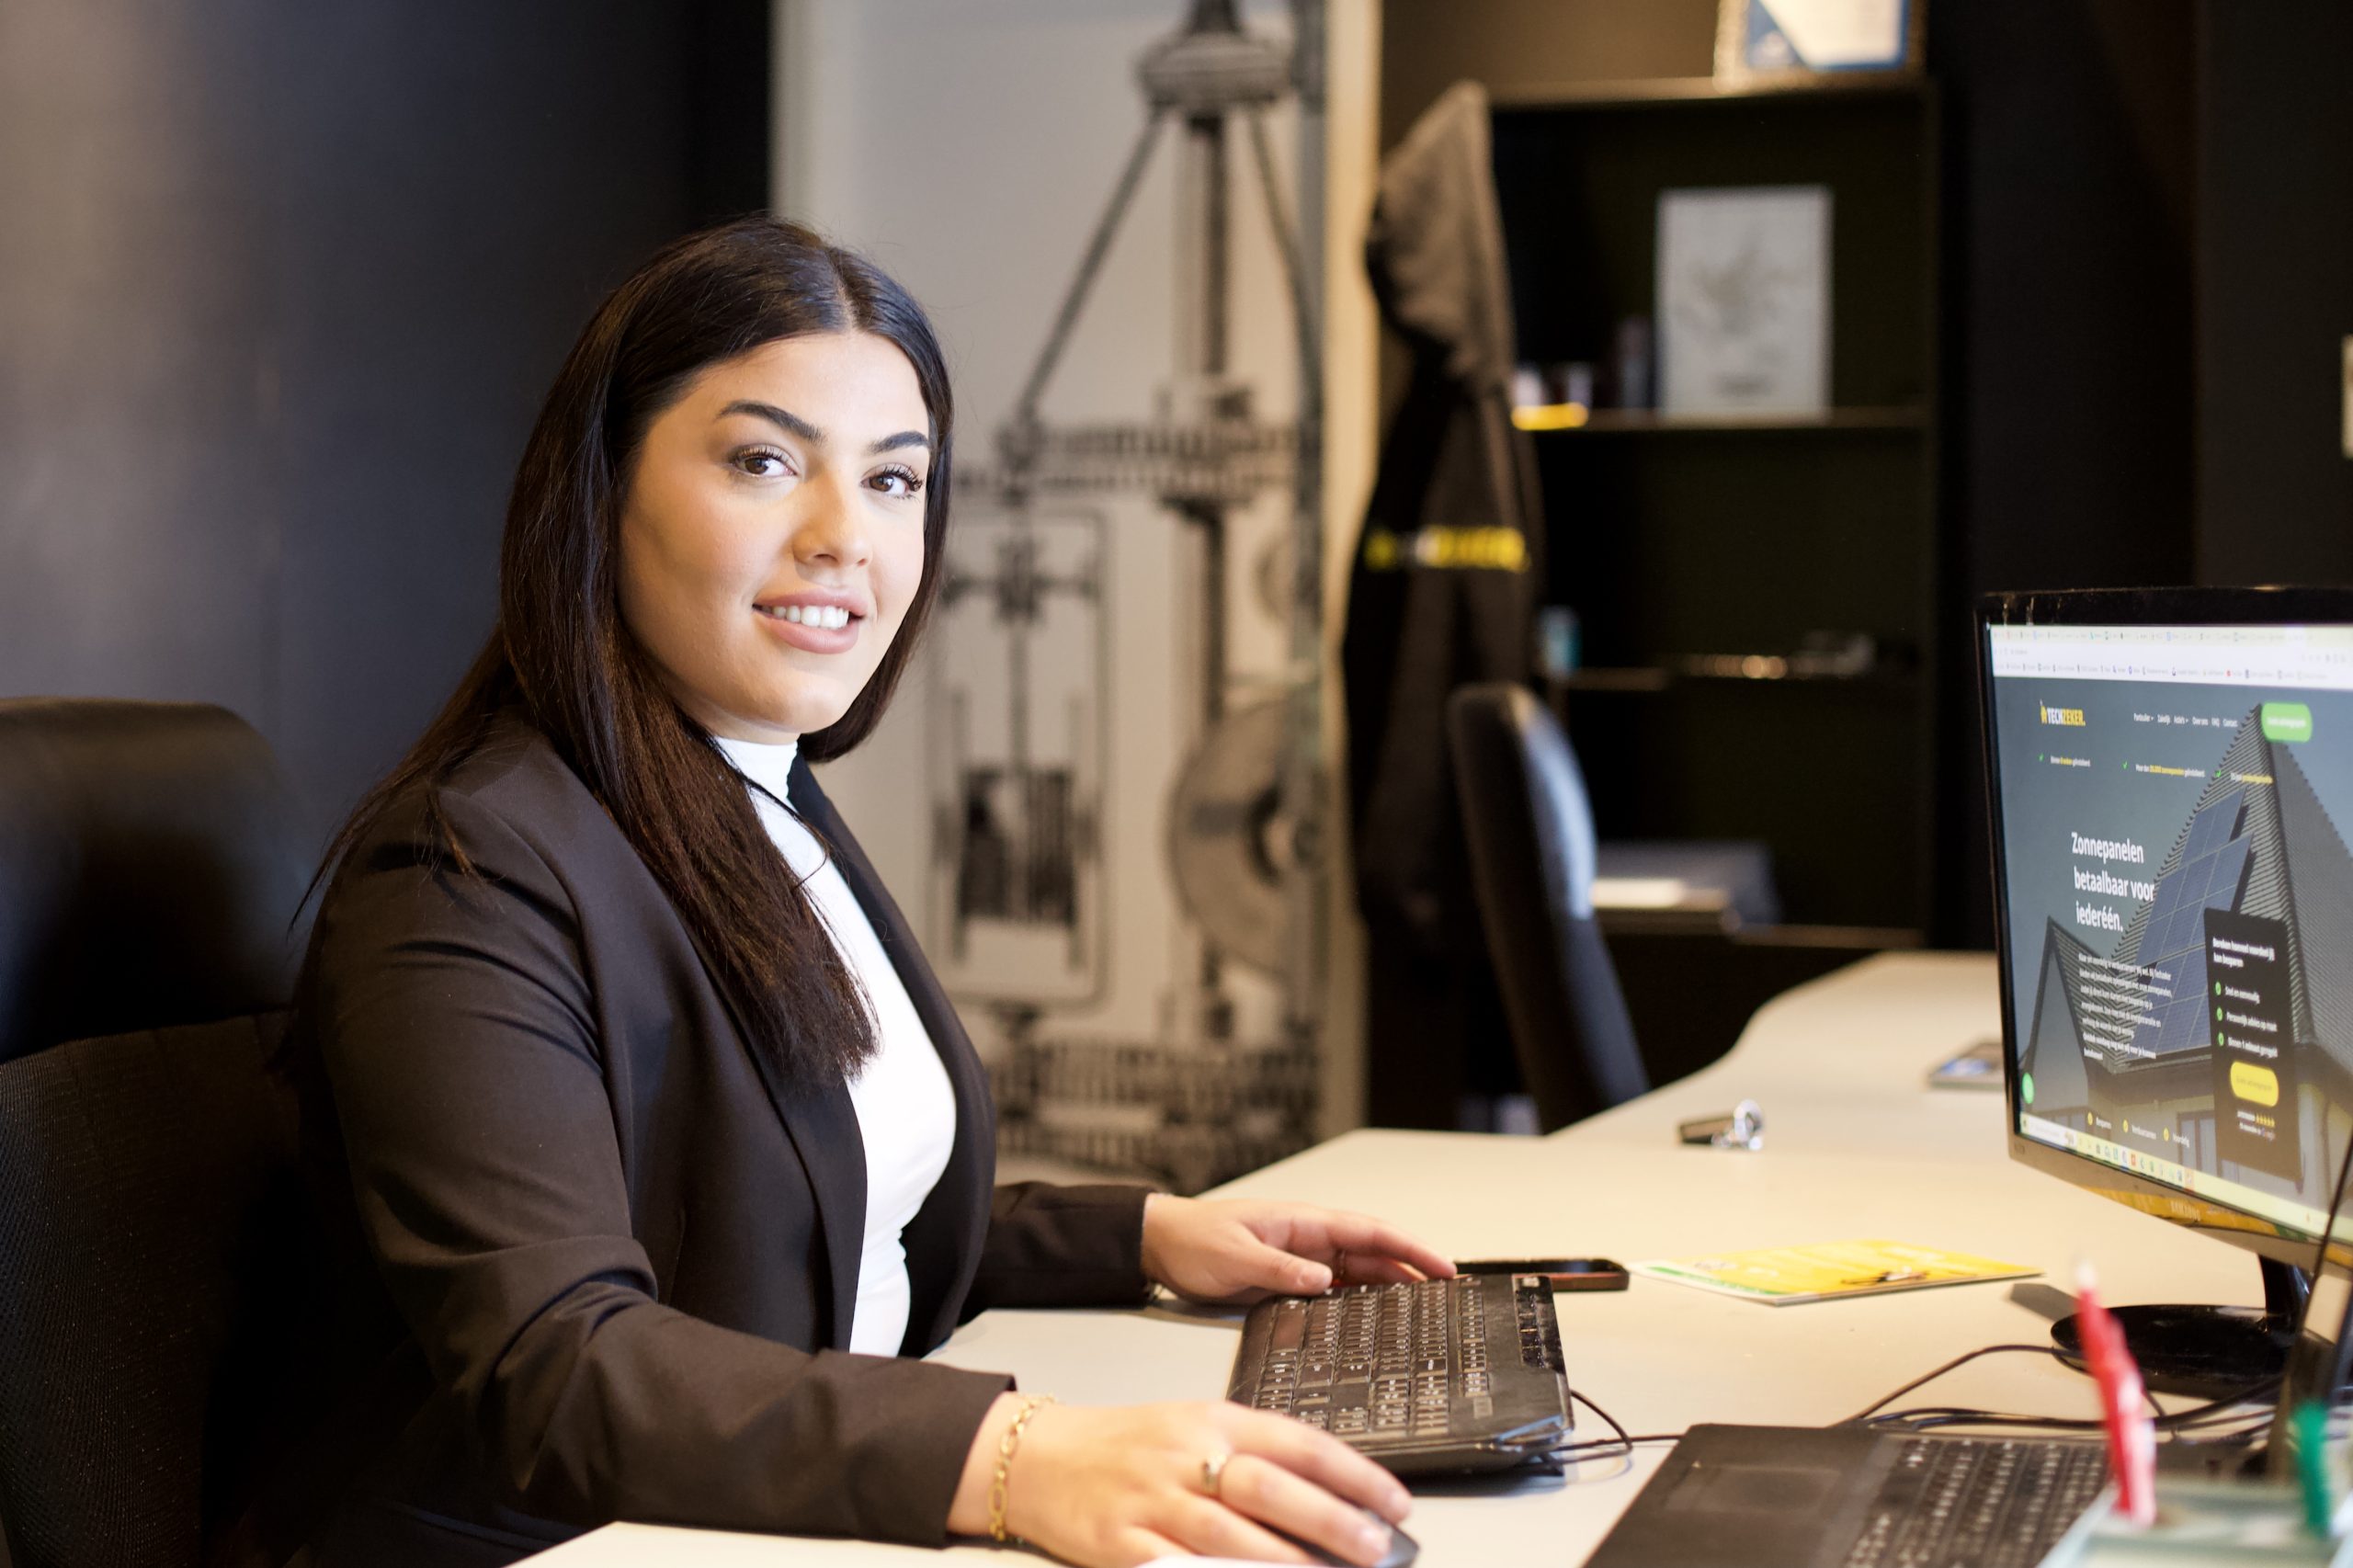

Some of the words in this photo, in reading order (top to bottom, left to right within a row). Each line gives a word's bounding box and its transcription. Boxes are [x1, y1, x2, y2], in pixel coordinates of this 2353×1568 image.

[2071, 832, 2144, 864] Zonnepanelen
[2074, 865, 2129, 897] betaalbaar
[2131, 881, 2155, 901] voor
[2075, 900, 2124, 932] iederéén.
